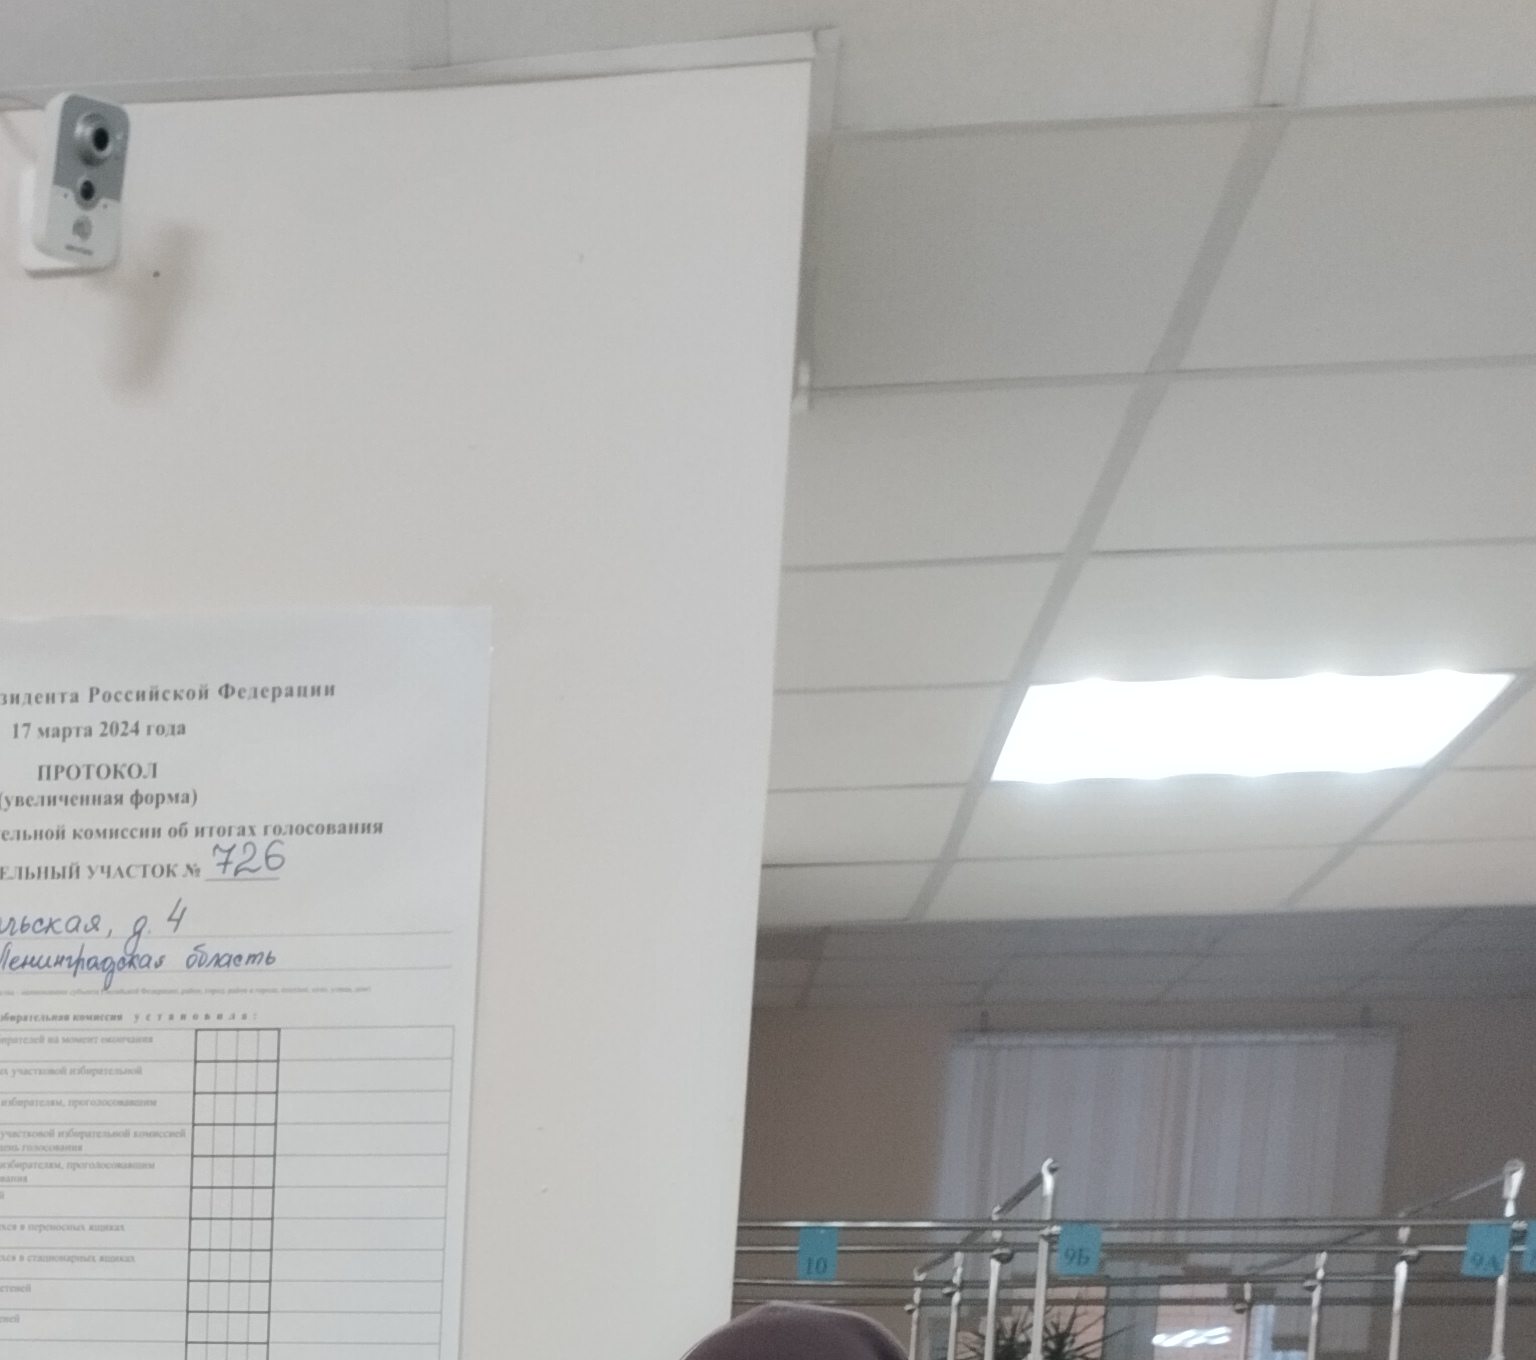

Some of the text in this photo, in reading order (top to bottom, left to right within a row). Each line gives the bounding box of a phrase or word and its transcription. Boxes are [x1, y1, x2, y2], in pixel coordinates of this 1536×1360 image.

[88, 683, 208, 704] Российской
[218, 680, 335, 706] Федерации
[11, 719, 186, 745] 17 марта 2024 года
[36, 762, 158, 782] ПРОТОКОЛ
[129, 788, 198, 812] форма)
[72, 826, 161, 840] комиссии
[167, 821, 187, 839] об
[194, 825, 255, 839] итогах
[263, 823, 383, 838] голосования
[88, 861, 176, 881] УЧАСТОК
[211, 840, 286, 876] 726
[166, 897, 188, 933] 4
[72, 1013, 123, 1021] комиссия
[805, 1258, 828, 1276] 10
